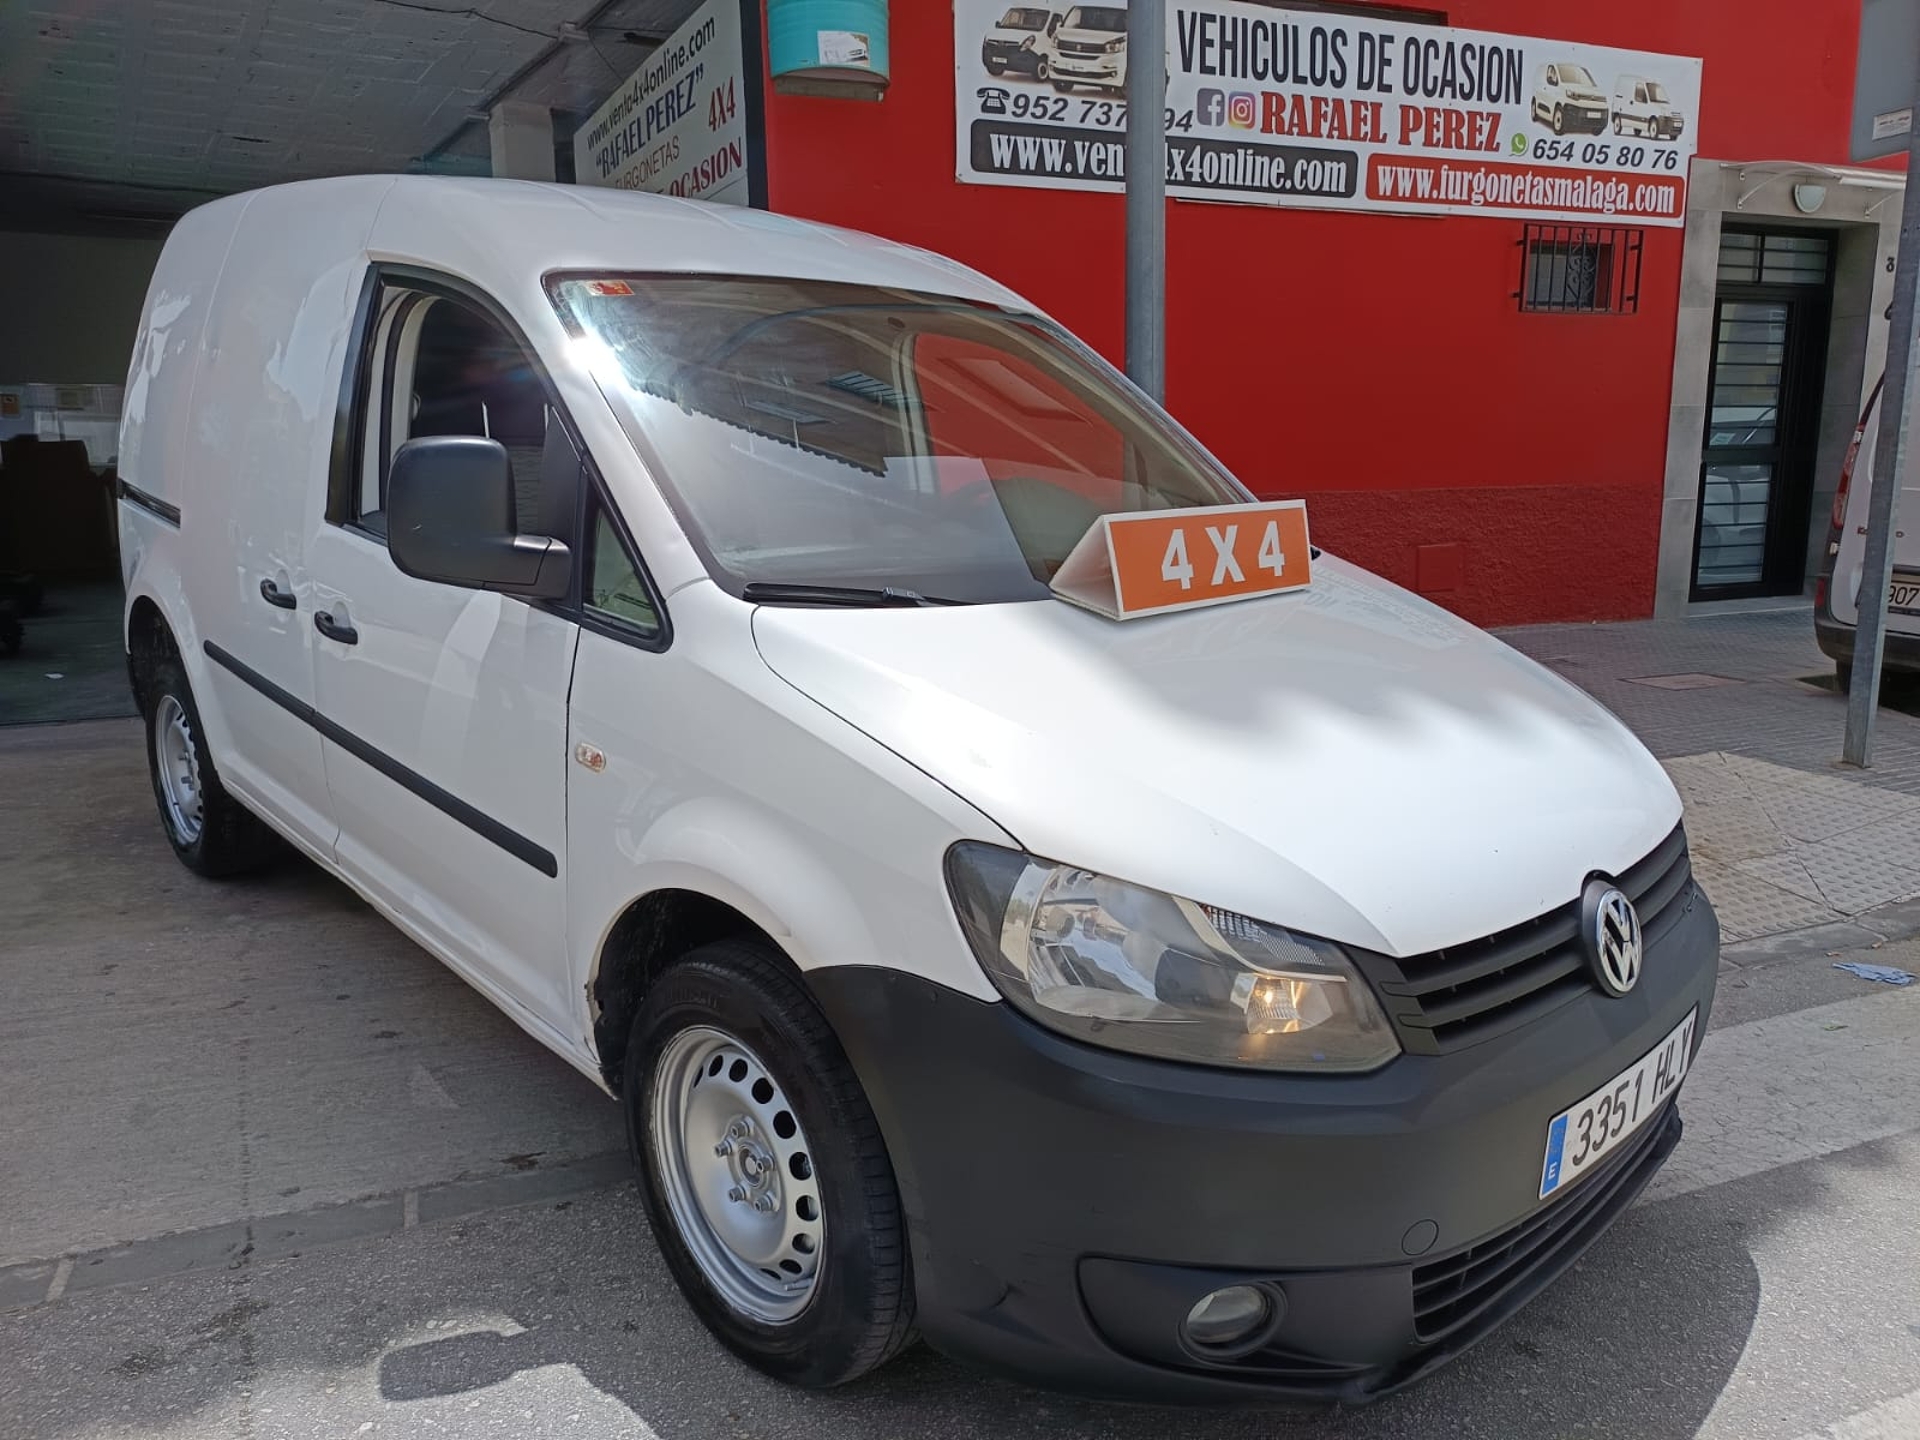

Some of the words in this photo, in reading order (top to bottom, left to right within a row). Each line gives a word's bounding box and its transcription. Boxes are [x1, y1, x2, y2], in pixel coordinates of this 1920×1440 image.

[1177, 10, 1348, 88] VEHICULOS
[1357, 31, 1395, 93] DE
[1403, 36, 1523, 105] OCASION
[708, 76, 736, 132] 4X4
[1012, 93, 1069, 122] 952
[1079, 100, 1128, 127] 737
[1164, 108, 1194, 132] 94
[1260, 91, 1387, 143] RAFAEL
[1398, 104, 1502, 152] PEREZ
[990, 134, 1346, 192] www.venx4online.com
[1533, 139, 1575, 161] 654
[1582, 143, 1610, 165] 05
[1616, 146, 1644, 167] 80
[1651, 149, 1678, 170] 76
[1377, 164, 1676, 214] www.furgonetasmalaga.com
[1572, 1069, 1644, 1166] 3351
